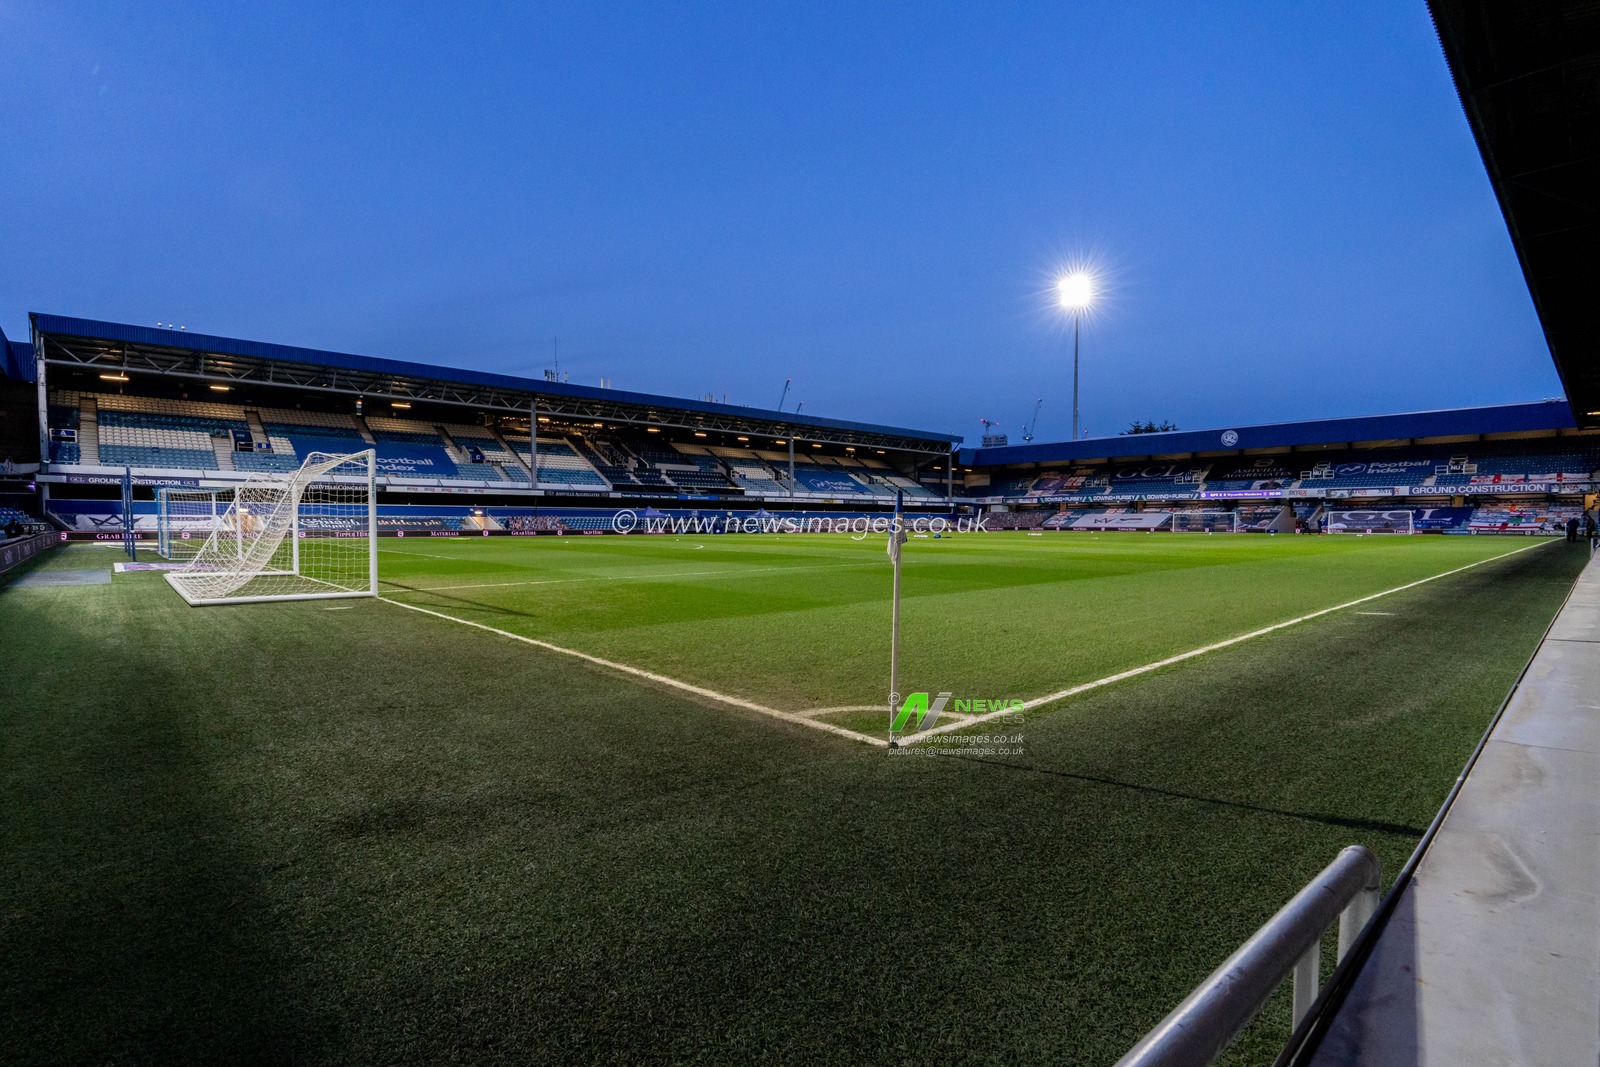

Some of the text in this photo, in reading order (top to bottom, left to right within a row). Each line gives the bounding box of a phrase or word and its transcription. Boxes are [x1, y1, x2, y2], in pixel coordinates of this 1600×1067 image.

[376, 457, 434, 466] ootball
[1369, 460, 1431, 468] Football
[376, 463, 417, 471] ndex
[1411, 484, 1546, 494] GROUND CONSTRUCTION
